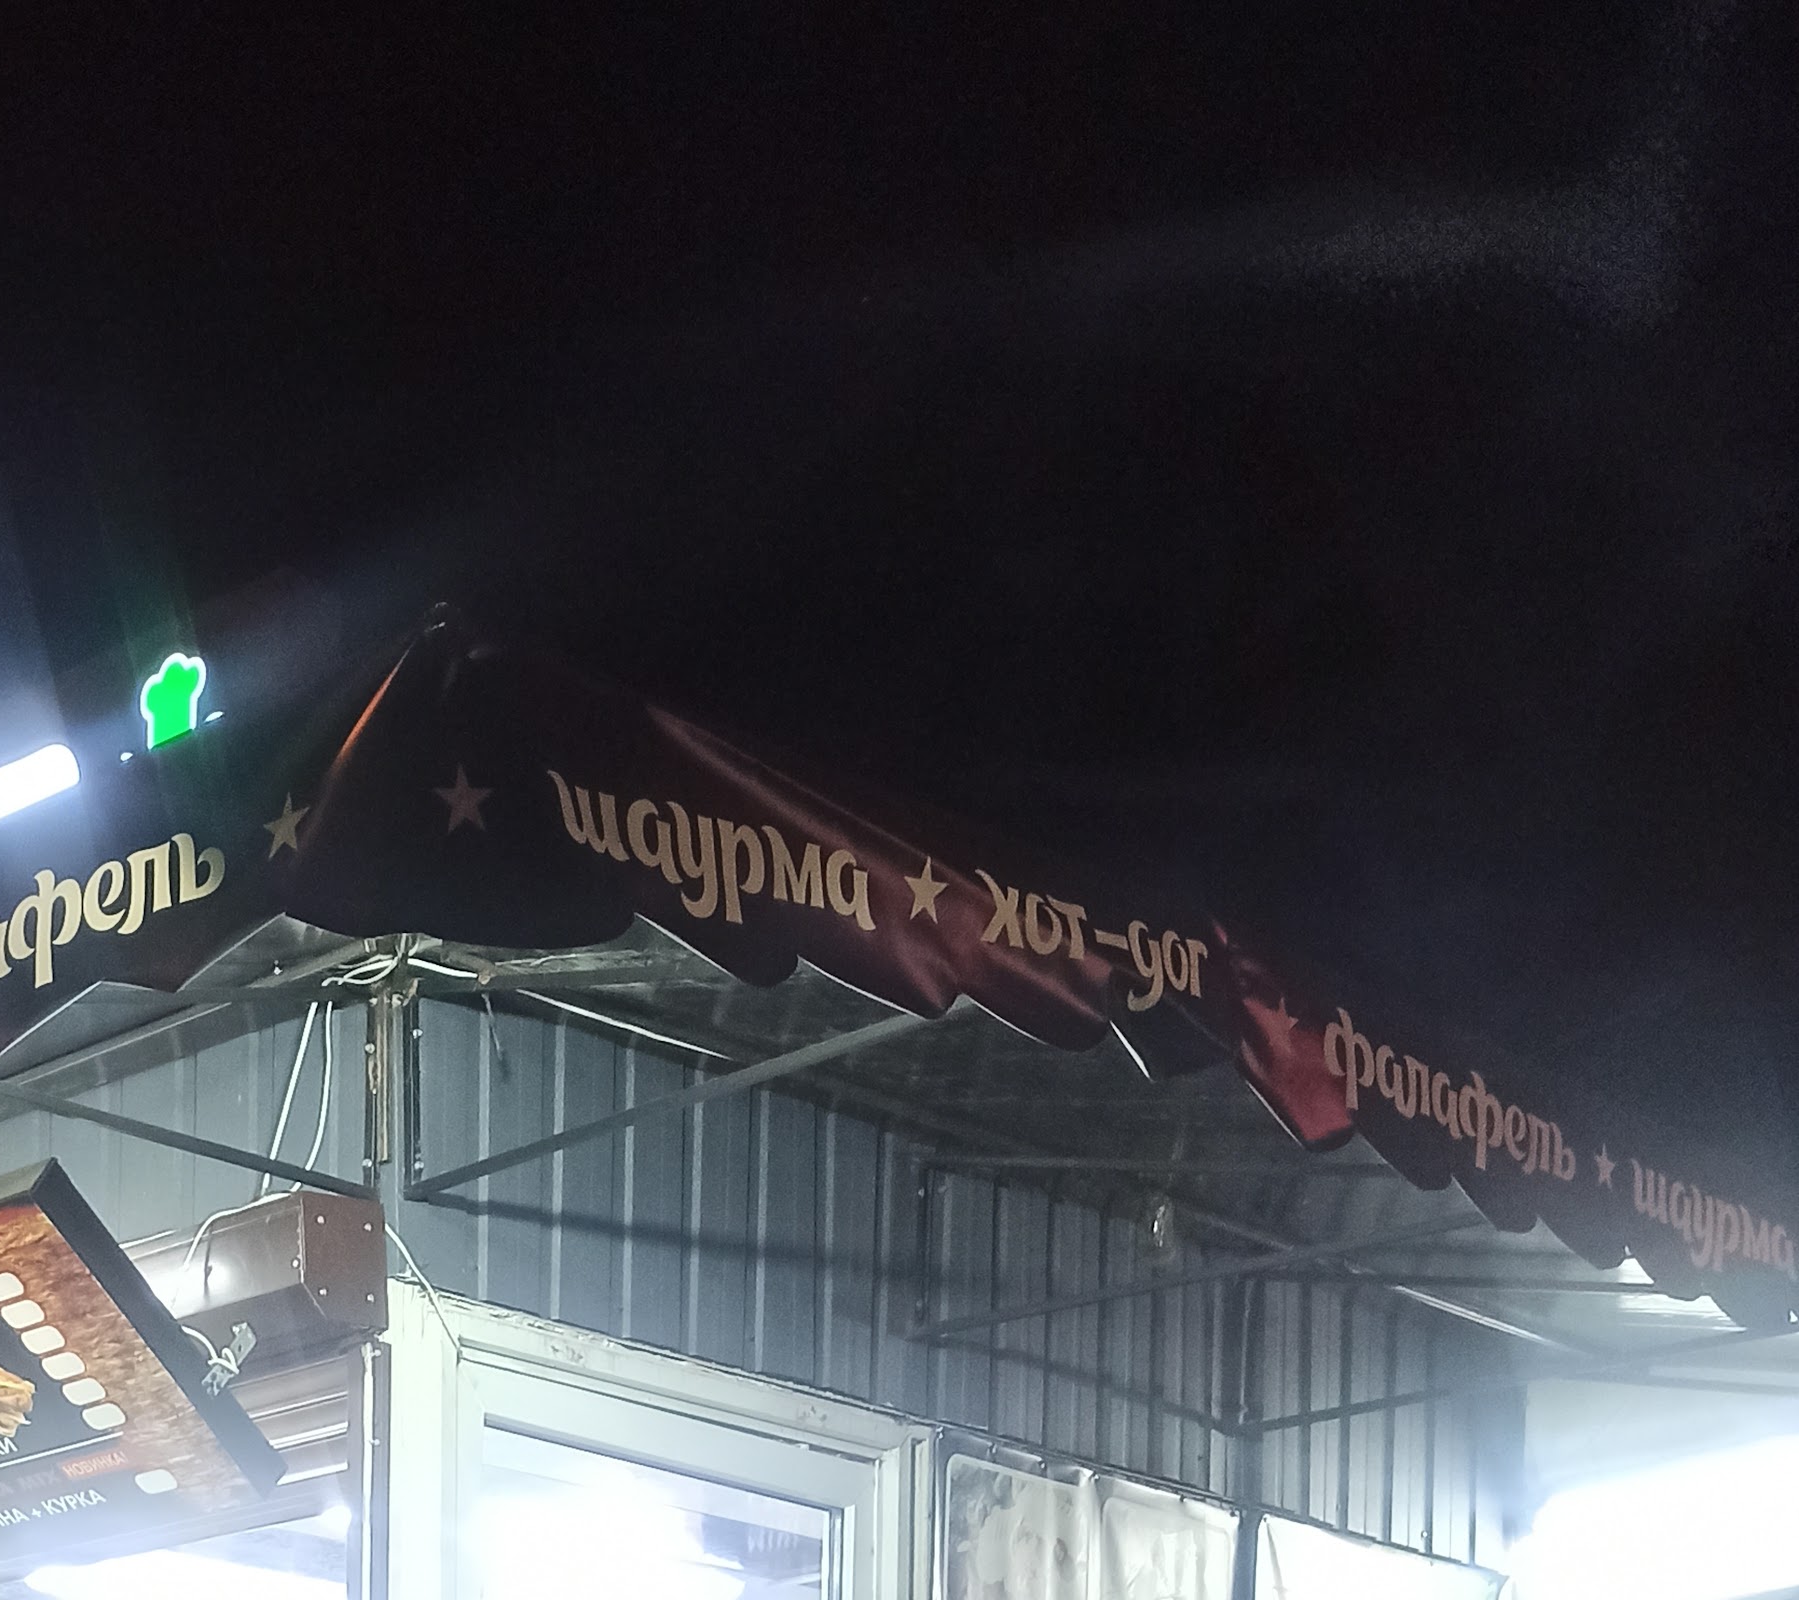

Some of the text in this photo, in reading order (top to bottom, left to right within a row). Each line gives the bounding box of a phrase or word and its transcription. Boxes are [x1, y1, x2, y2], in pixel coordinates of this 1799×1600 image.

[547, 769, 1798, 1282] шаурма хот-дог фалафель шаурма
[41, 1489, 106, 1515] КУРКА
